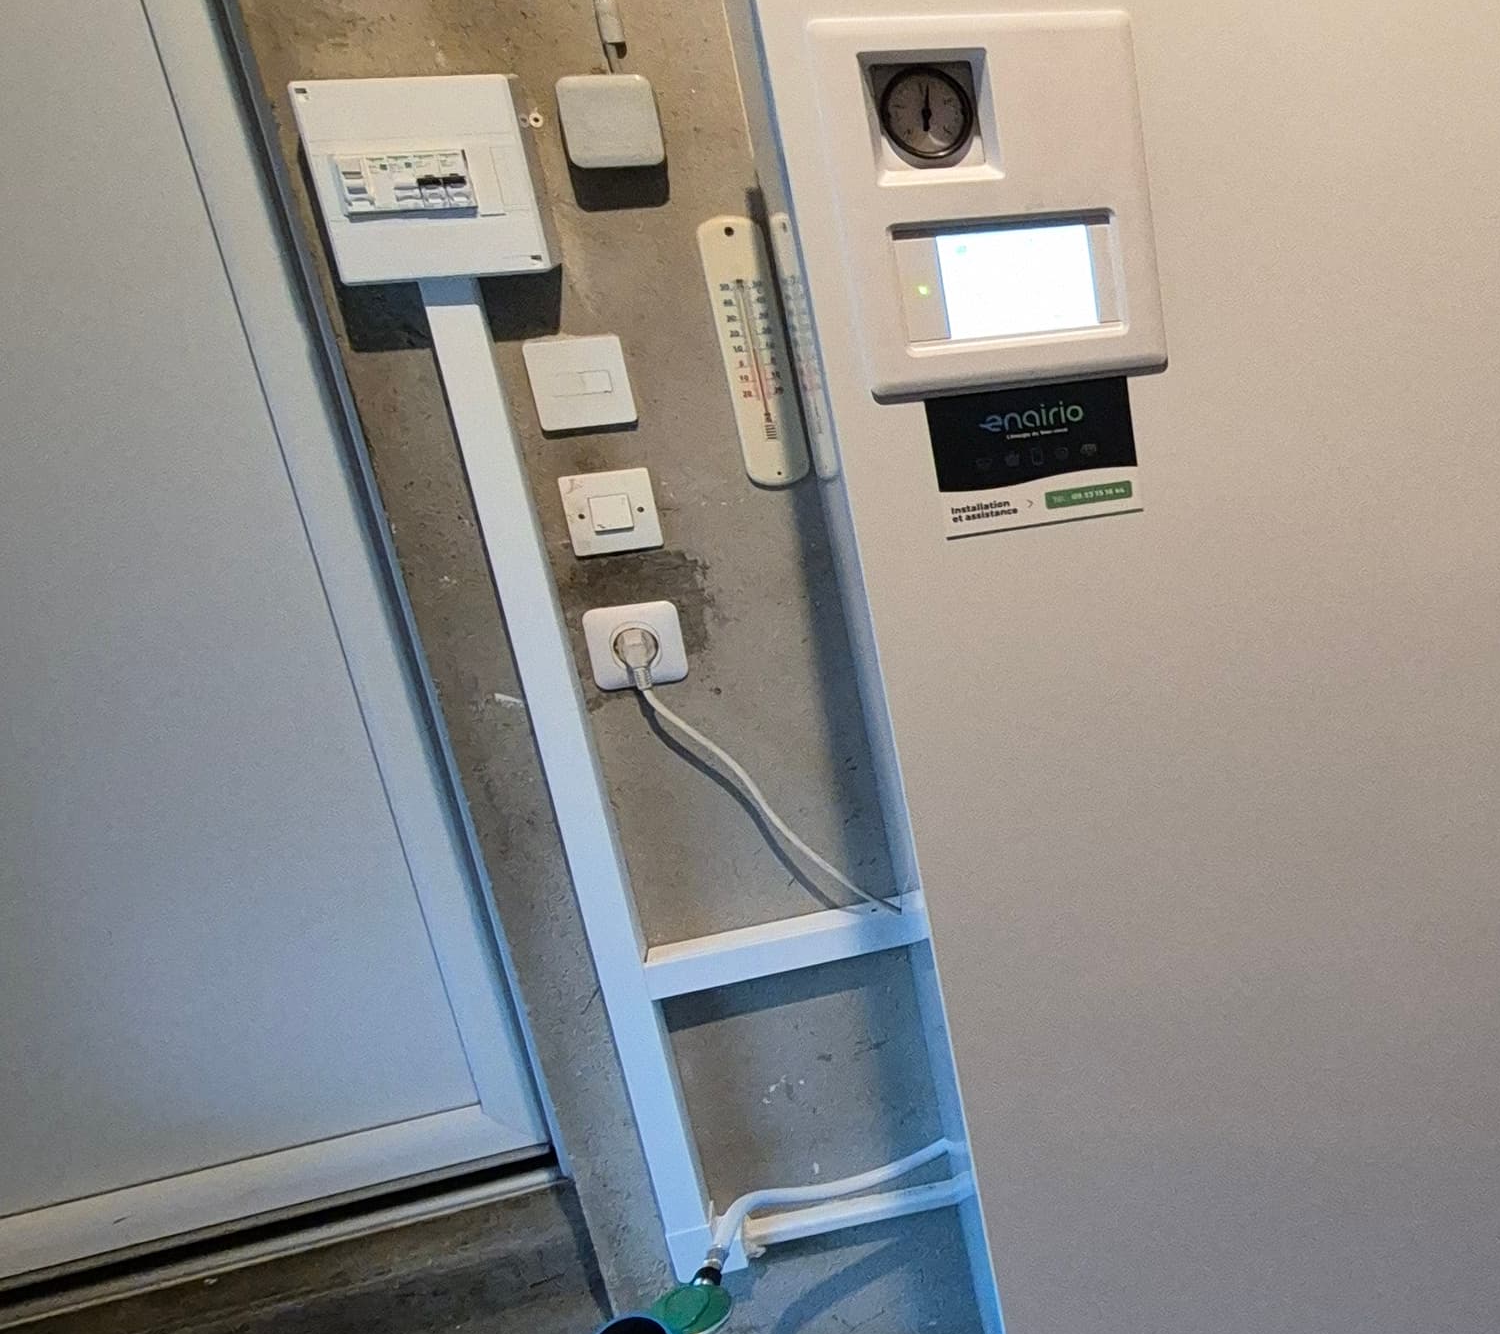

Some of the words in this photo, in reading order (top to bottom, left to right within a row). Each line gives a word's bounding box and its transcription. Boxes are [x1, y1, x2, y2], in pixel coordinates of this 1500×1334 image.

[979, 400, 1084, 433] enairio
[951, 500, 1010, 515] Installation
[952, 515, 963, 523] et
[965, 508, 1018, 521] assistance
